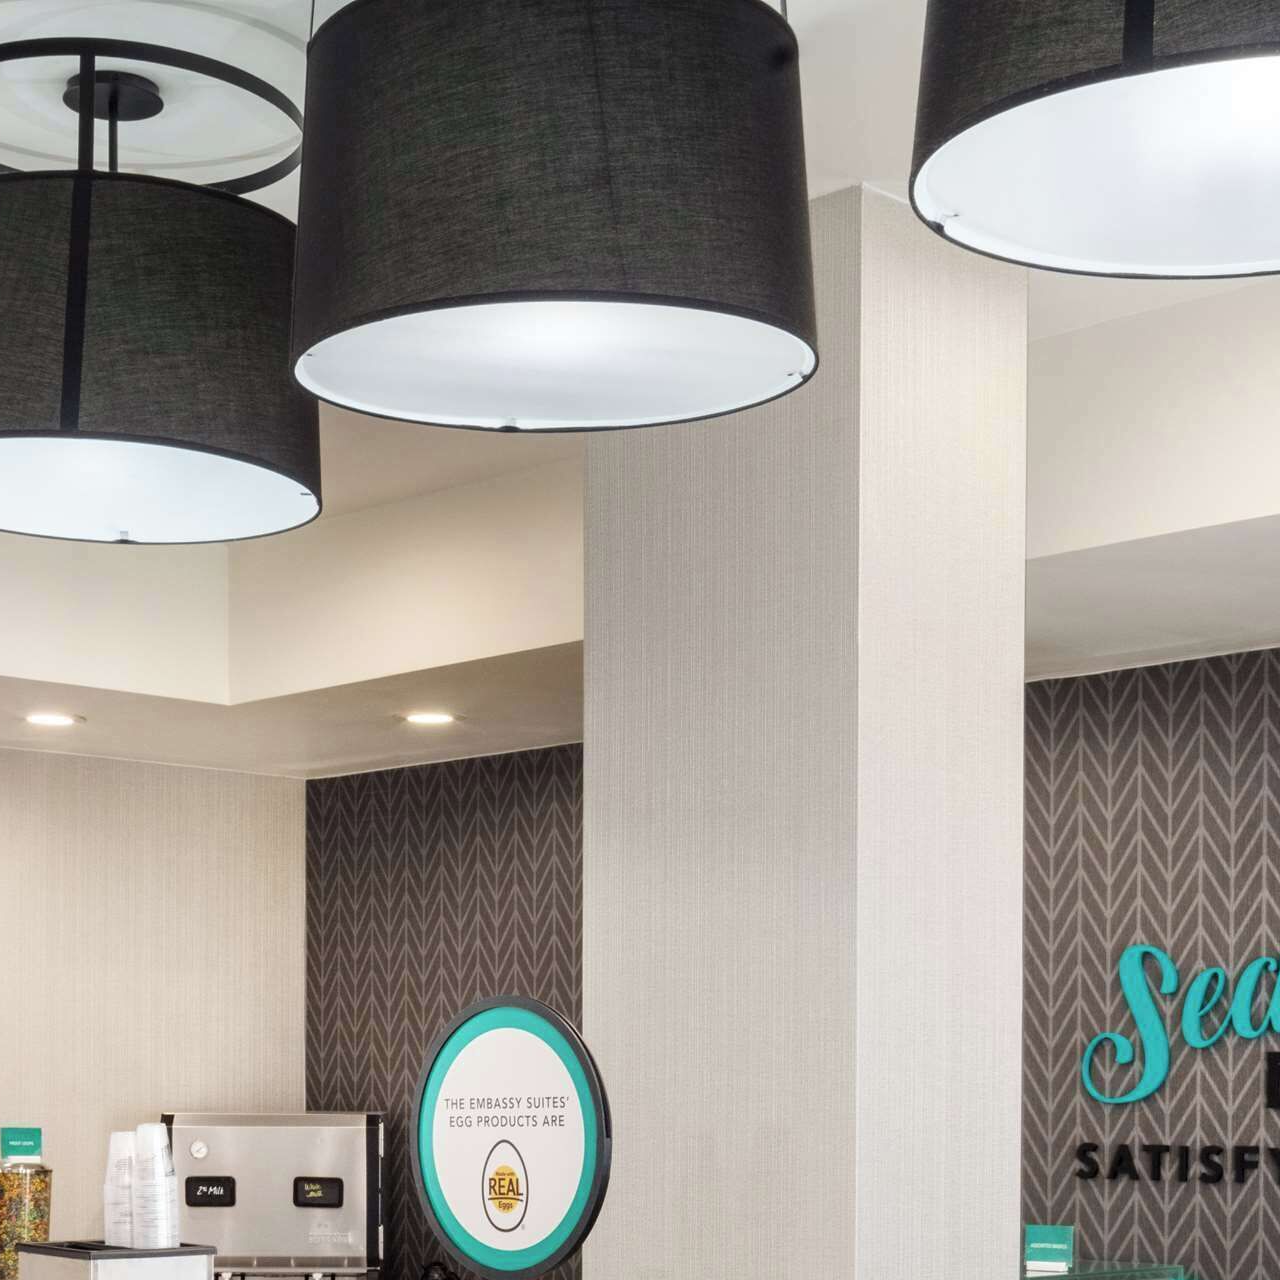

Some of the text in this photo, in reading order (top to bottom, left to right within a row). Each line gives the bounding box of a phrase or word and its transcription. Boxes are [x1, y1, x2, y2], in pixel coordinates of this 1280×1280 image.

[444, 1098, 465, 1110] THE
[469, 1097, 521, 1110] EMBASSY
[449, 1115, 565, 1127] EGG PRODUCTS ARE
[488, 1178, 524, 1196] REAL
[498, 1200, 513, 1210] Eggs
